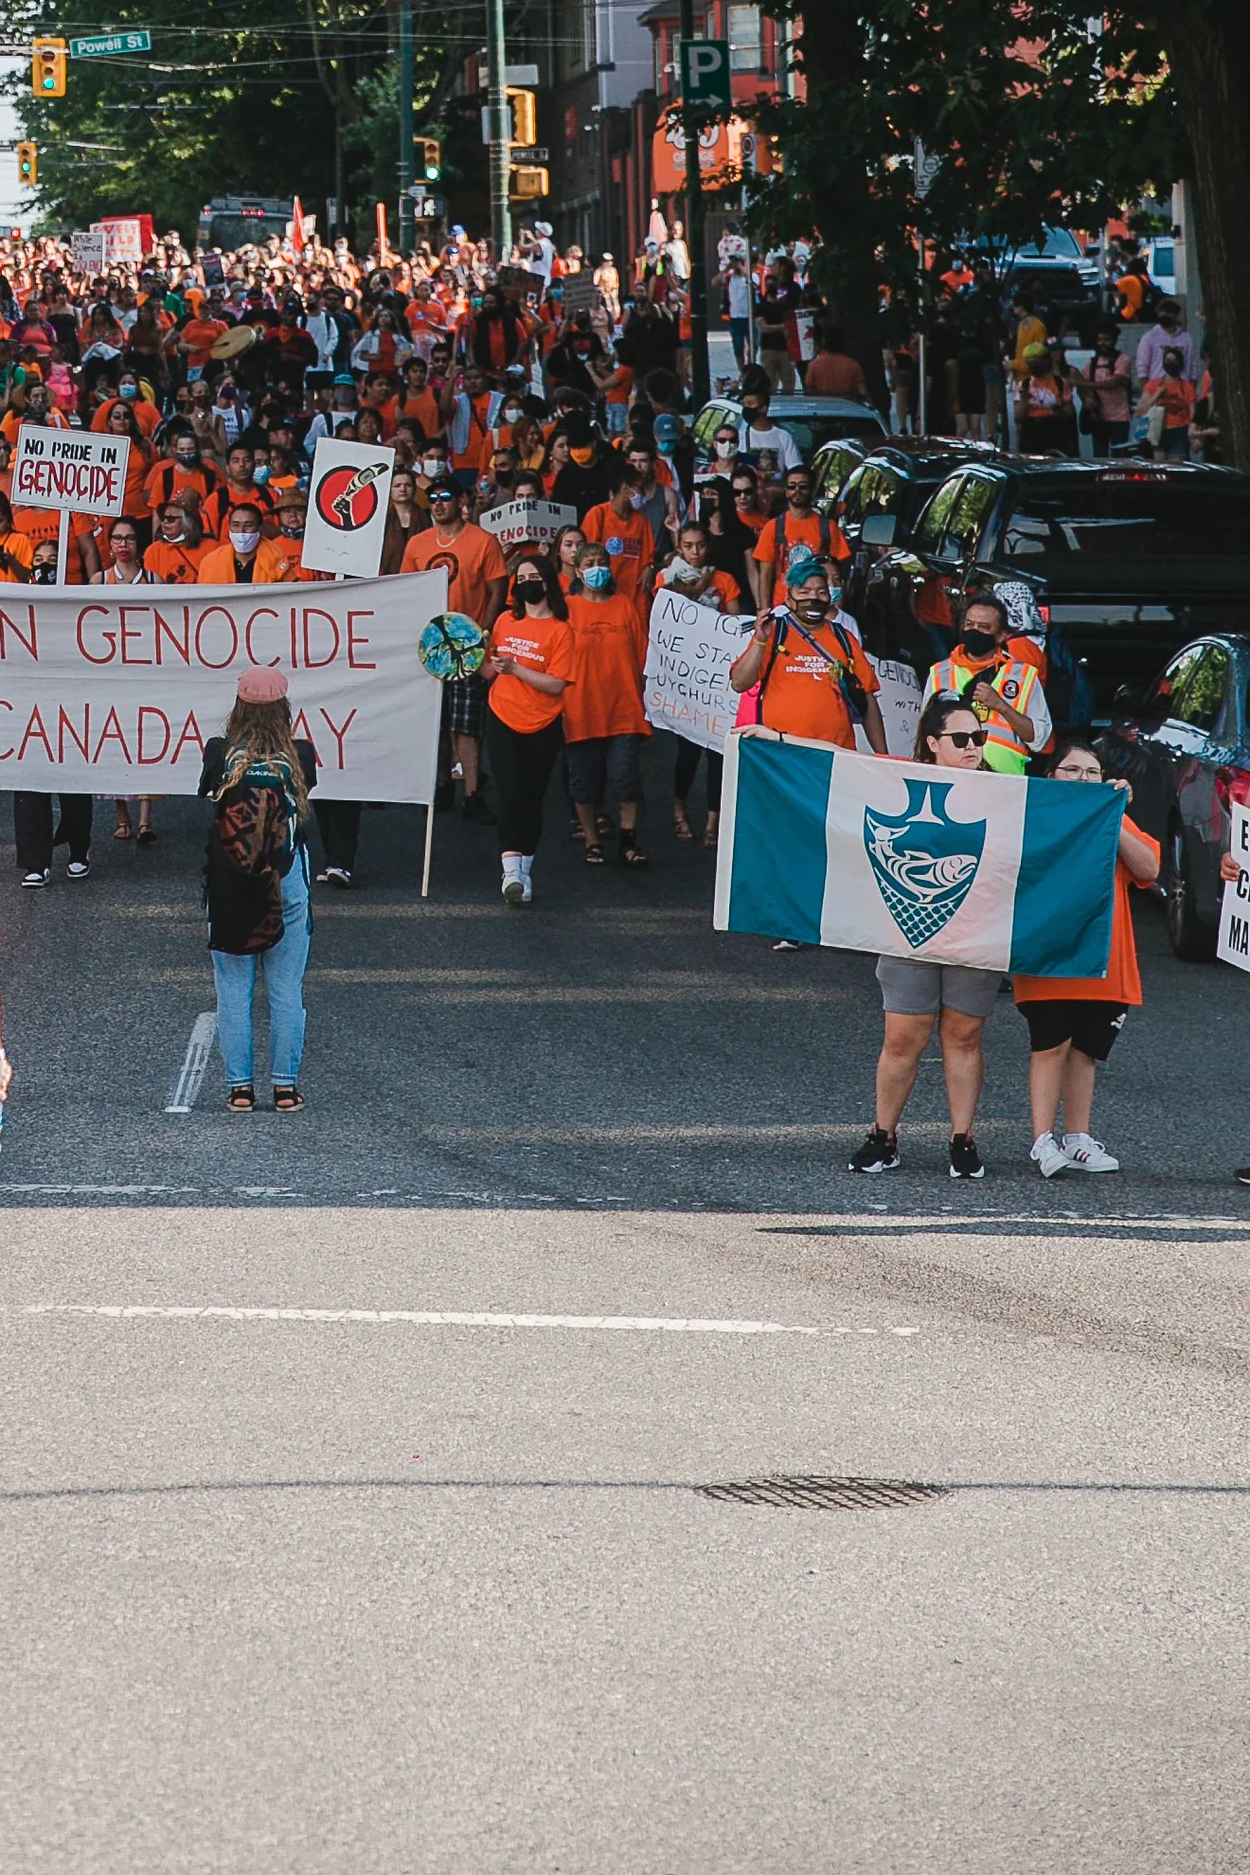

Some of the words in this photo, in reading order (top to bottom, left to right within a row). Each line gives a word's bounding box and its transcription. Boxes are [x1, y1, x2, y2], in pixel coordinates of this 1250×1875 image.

[77, 37, 122, 54] Powell
[126, 35, 143, 48] St
[688, 46, 722, 88] P
[24, 438, 44, 456] NO
[51, 441, 92, 461] PRIDE
[100, 447, 118, 464] IN
[18, 459, 121, 506] GENOCIDE
[490, 510, 502, 523] NO
[509, 500, 538, 515] PRIDE
[547, 504, 561, 516] IN
[496, 525, 558, 542] ENOCIDE
[662, 597, 699, 625] NO
[76, 605, 378, 670] GENOCIDE
[504, 636, 540, 649] JUSTICE
[511, 643, 530, 652] FOR
[657, 629, 685, 653] WE
[695, 642, 738, 664] STA
[895, 700, 921, 713] WITH
[655, 674, 739, 716] UYGHURS
[649, 691, 728, 738] SHAME
[293, 707, 358, 770] AY
